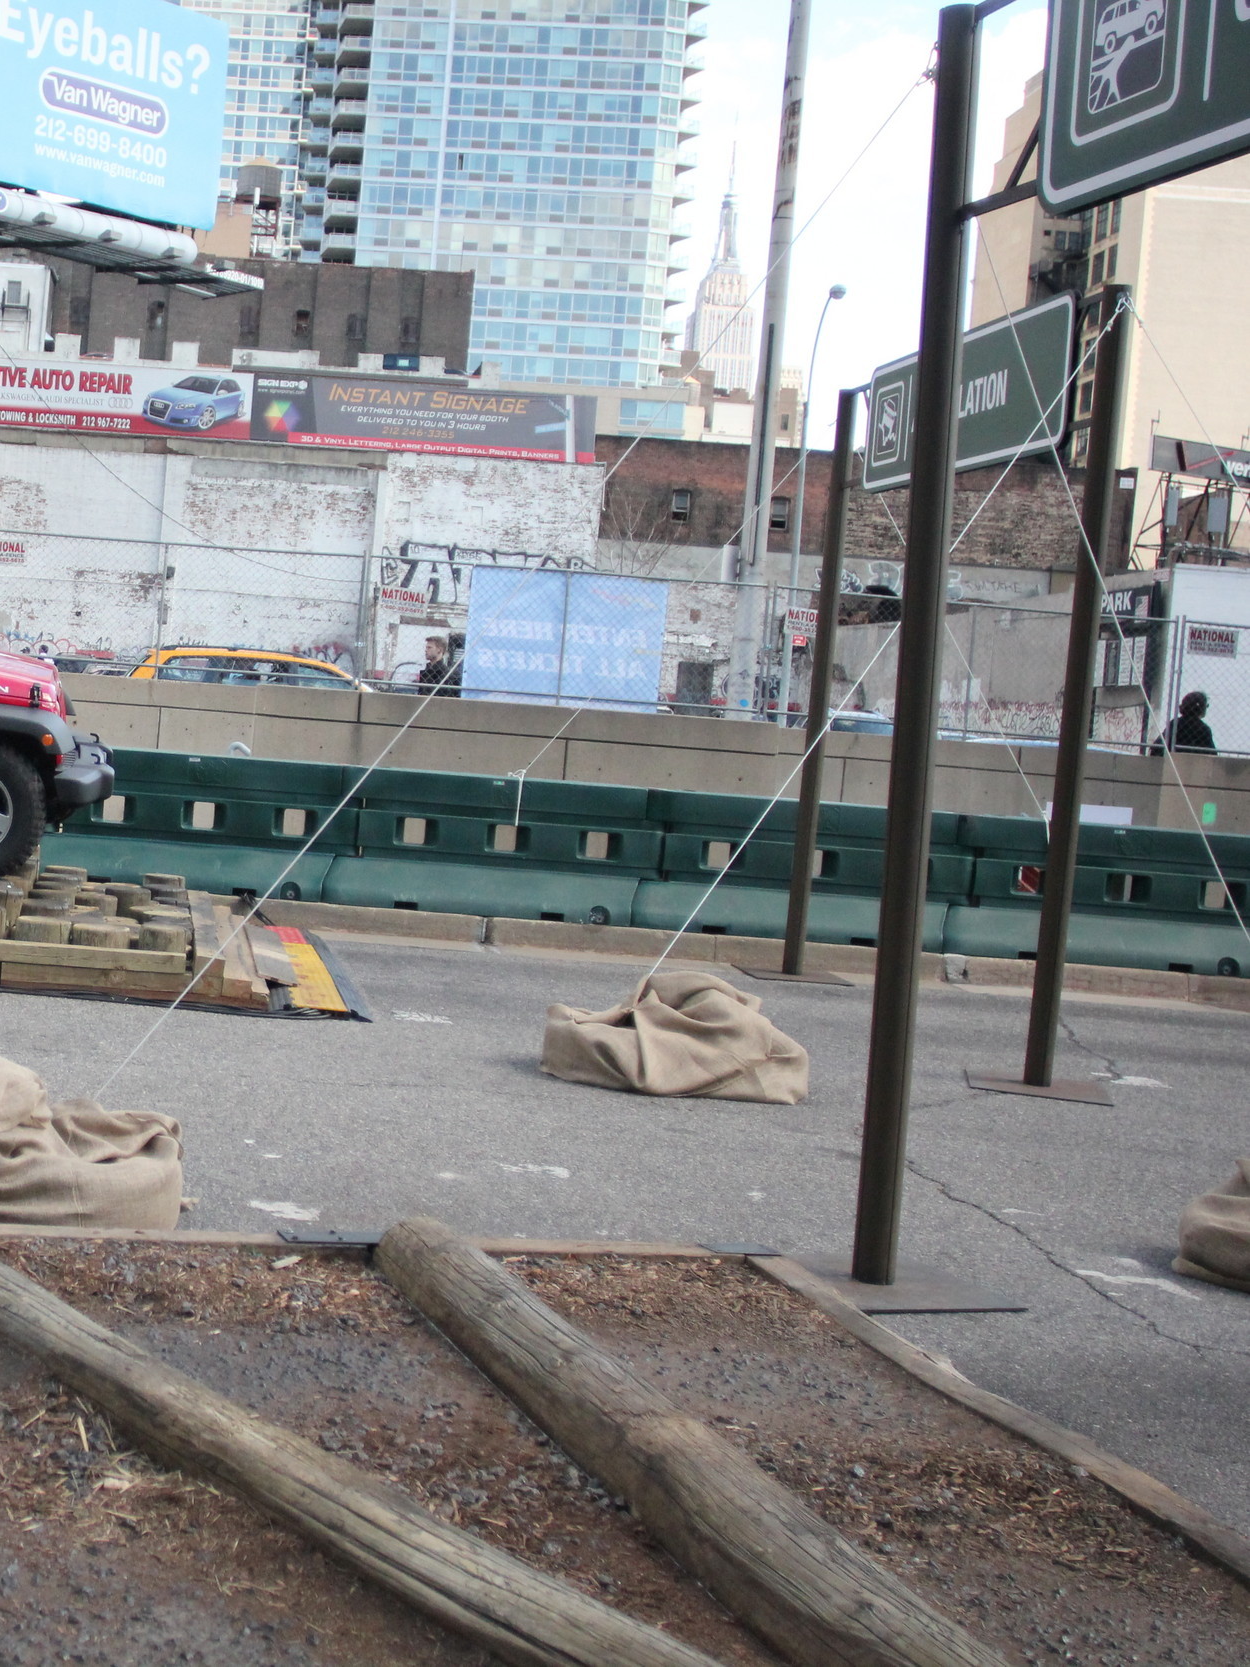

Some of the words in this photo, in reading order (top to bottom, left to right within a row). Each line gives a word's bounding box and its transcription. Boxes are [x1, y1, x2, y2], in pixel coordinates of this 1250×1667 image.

[51, 77, 88, 108] Van
[90, 86, 162, 127] Wagner
[34, 114, 168, 169] 212-699-8400
[34, 142, 166, 188] www.vanwagner.com
[30, 367, 75, 392] AUTO
[79, 371, 133, 395] REPAIR
[257, 378, 279, 387] SIGN
[44, 395, 62, 404] AUDI
[62, 396, 104, 406] SPECIALIST
[329, 383, 426, 407] INSTANT
[430, 391, 530, 415] SIGNAGE
[28, 412, 33, 422] &
[35, 412, 76, 425] LOCKSMITH
[82, 416, 95, 427] 212
[97, 417, 131, 429] 967-7222
[340, 405, 393, 415] EVERYTHING
[395, 408, 412, 416] YOU
[413, 409, 435, 418] NEED
[436, 411, 454, 419] FOR
[456, 412, 478, 421] YOUR
[479, 414, 510, 423] BOOTH
[357, 415, 404, 425] DELIVERED
[406, 418, 417, 426] TO
[419, 419, 437, 428] YOU
[448, 420, 455, 429] 3
[456, 423, 486, 431] HOURS
[382, 426, 399, 436] 212
[301, 435, 314, 443] 3D
[314, 435, 321, 443] &
[324, 436, 346, 445] VINYL
[348, 438, 394, 448] LETTERING,
[395, 442, 422, 450] LARGE
[423, 443, 455, 452] OUTPUT
[457, 446, 488, 455] DIGITAL
[521, 450, 560, 459] BANNERS
[381, 587, 426, 604] NATIONAL
[1100, 590, 1132, 613] PARK
[788, 609, 819, 623] NATIO
[1189, 628, 1236, 644] NATIONAL
